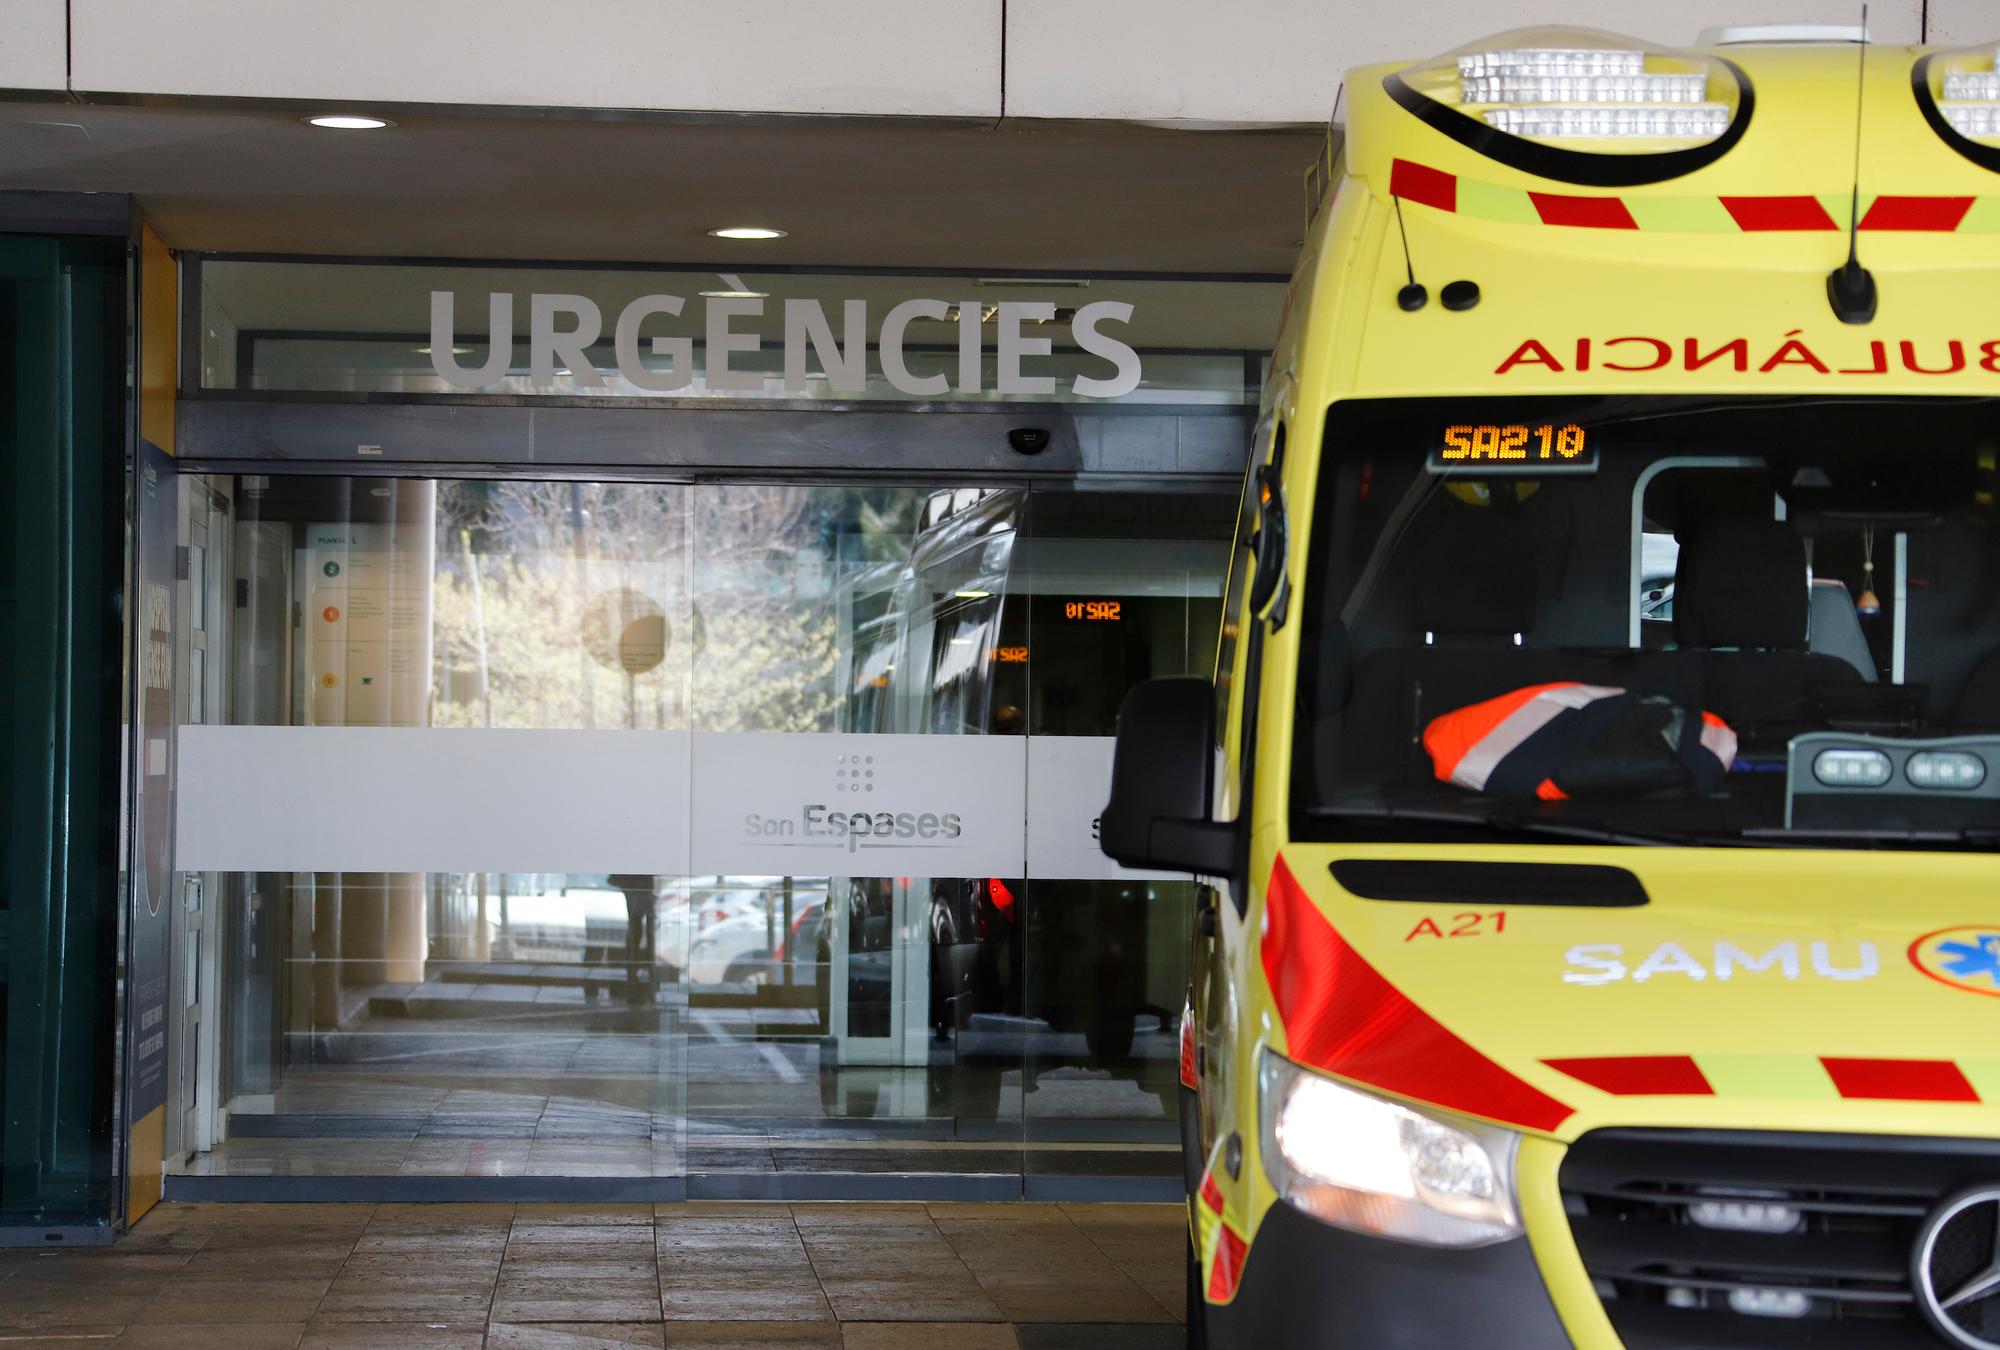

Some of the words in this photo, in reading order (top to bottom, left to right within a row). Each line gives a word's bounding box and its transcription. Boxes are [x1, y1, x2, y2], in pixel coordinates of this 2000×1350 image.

[430, 274, 1142, 398] URGÈNCIES
[1442, 424, 1584, 459] SA210
[744, 813, 794, 837] Son
[803, 804, 961, 853] Espases
[1405, 911, 1507, 942] A21
[1561, 941, 1880, 986] SAMU
